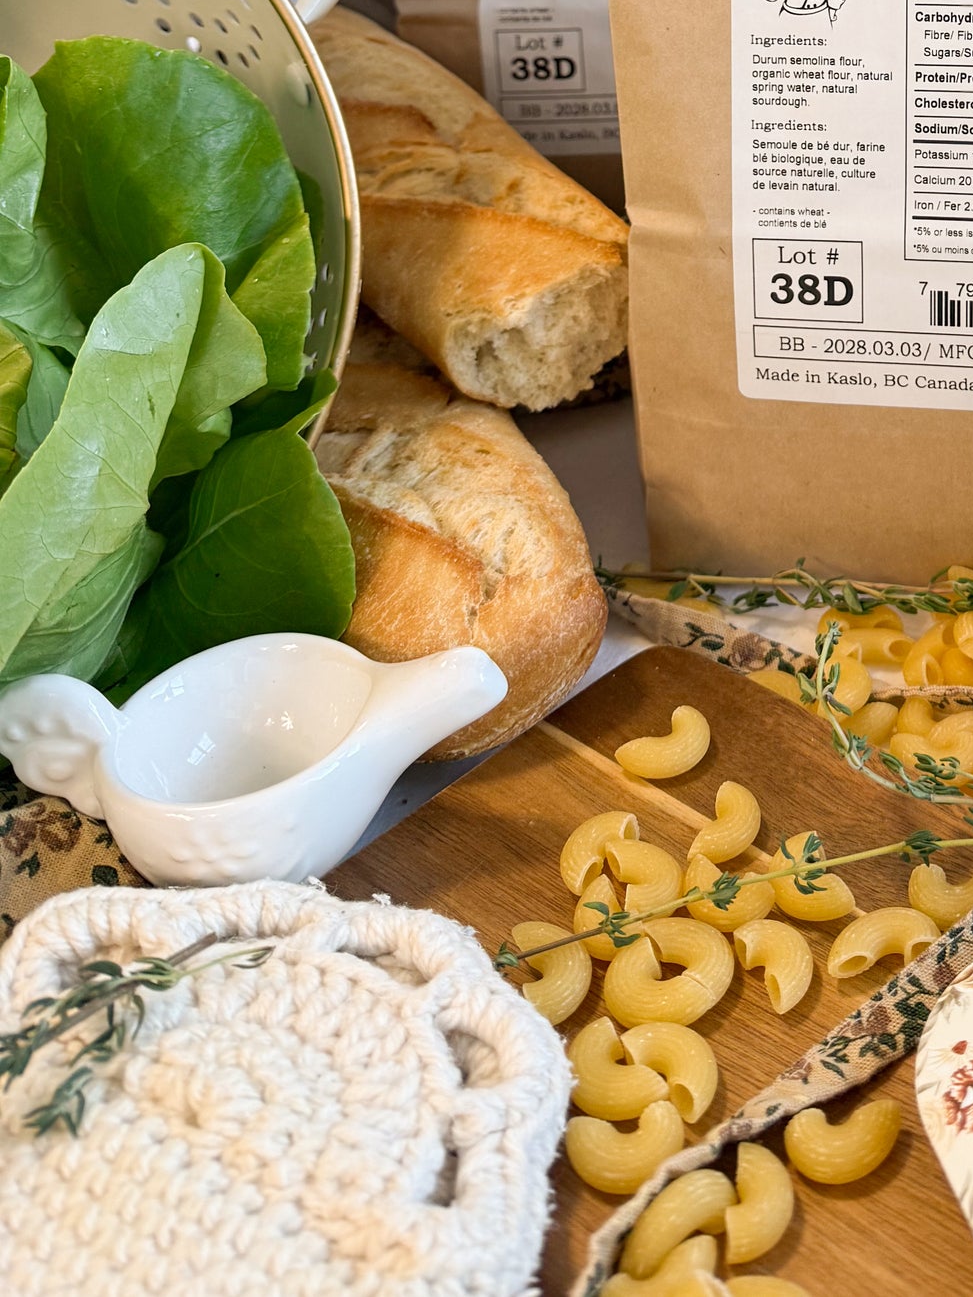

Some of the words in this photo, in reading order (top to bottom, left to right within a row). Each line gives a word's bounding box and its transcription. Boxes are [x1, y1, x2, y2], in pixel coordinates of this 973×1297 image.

[514, 35, 546, 52] Lot
[751, 34, 827, 48] Ingredients:
[753, 54, 787, 64] Durum
[790, 56, 835, 66] semolina
[839, 56, 865, 68] flour,
[511, 57, 576, 81] 38D
[752, 69, 790, 80] organic
[793, 70, 824, 79] wheat
[828, 70, 853, 81] flour,
[857, 72, 892, 81] natural
[752, 82, 783, 94] spring
[787, 83, 818, 94] water,
[822, 84, 857, 94] natural
[752, 96, 809, 109] sourdough.
[751, 120, 827, 132] Ingredients:
[752, 139, 797, 150] Semoule
[801, 141, 813, 150] de
[817, 141, 829, 150] bé
[833, 142, 852, 152] dur,
[857, 142, 885, 152] farine
[753, 153, 768, 163] blé
[771, 154, 826, 166] biologique,
[830, 157, 849, 165] eau
[853, 156, 865, 165] de
[915, 149, 968, 160] Potassium
[753, 168, 787, 176] source
[791, 168, 837, 179] naturelle,
[841, 169, 876, 179] culture
[914, 174, 956, 185] Calcium
[959, 176, 972, 186] 20
[753, 180, 765, 190] de
[769, 181, 798, 190] levain
[802, 182, 840, 191] natural.
[797, 208, 824, 216] wheat
[914, 200, 934, 210] Iron
[944, 201, 961, 211] Fer
[758, 219, 798, 227] contients
[800, 220, 811, 228] de
[814, 220, 827, 228] blé
[946, 228, 963, 237] less
[778, 246, 817, 265] Lot
[826, 248, 839, 265] #
[770, 273, 853, 306] 38D
[919, 281, 928, 295] 7
[779, 336, 805, 351] BB
[756, 368, 799, 382] Made
[806, 370, 821, 383] in
[828, 372, 877, 388] Kaslo,
[884, 374, 908, 387] BC
